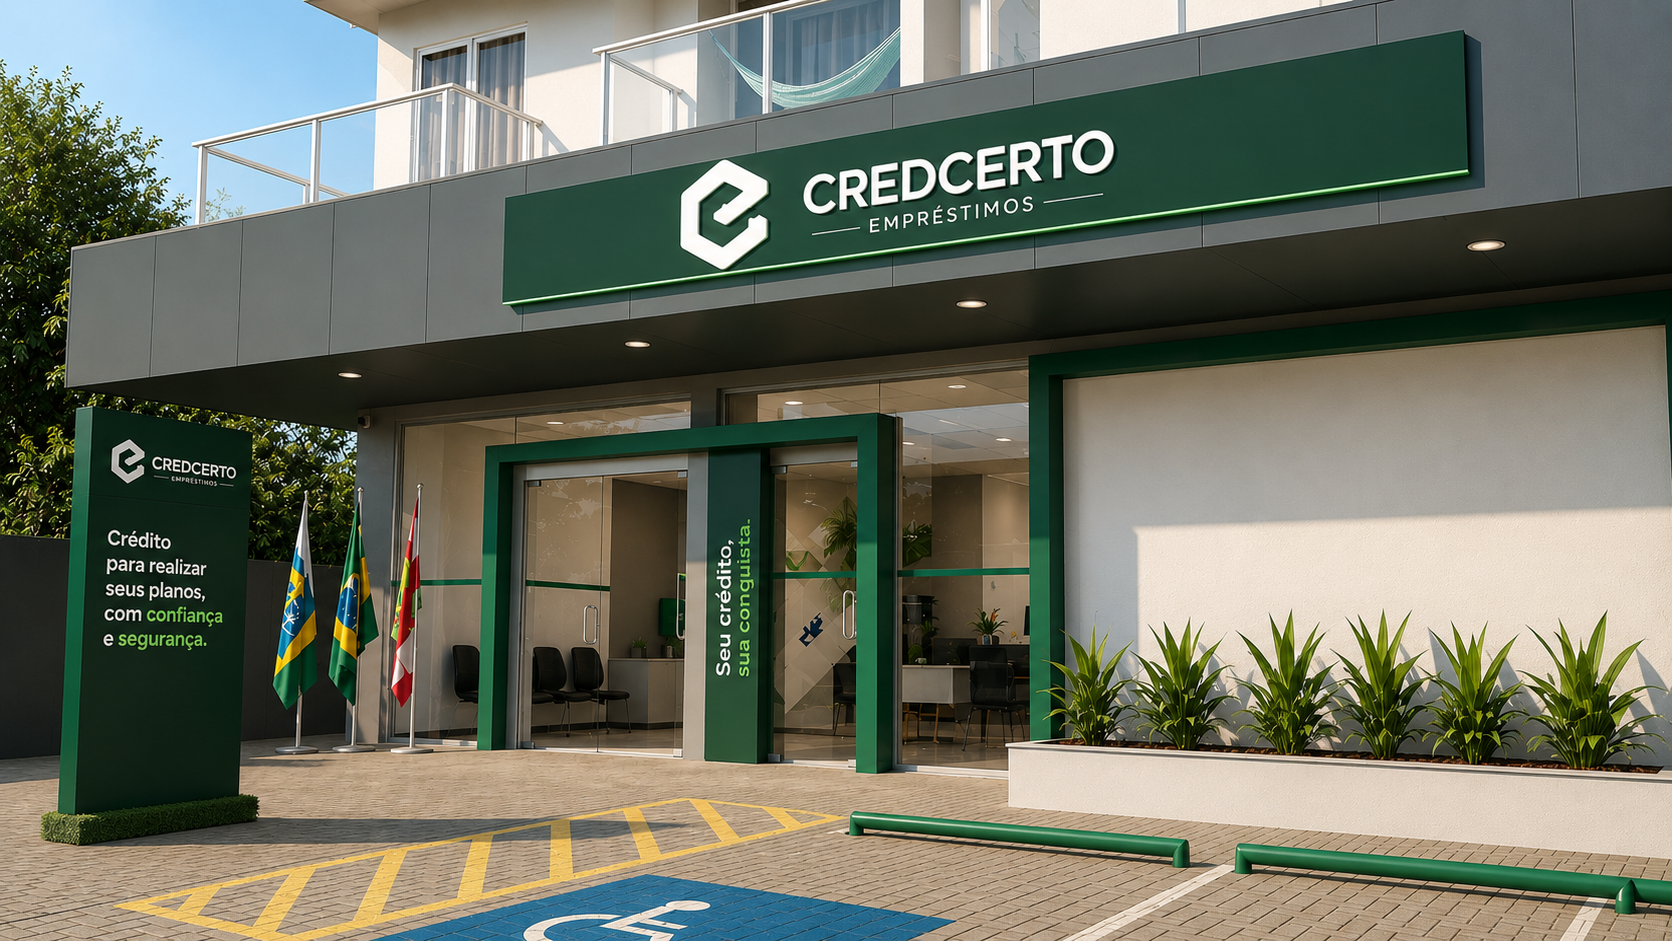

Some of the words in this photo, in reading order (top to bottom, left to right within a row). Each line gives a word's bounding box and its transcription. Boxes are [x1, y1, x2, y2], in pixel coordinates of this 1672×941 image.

[803, 129, 1115, 215] CREDCERTO
[869, 195, 1035, 234] EMPRÉSTIMOS
[151, 456, 237, 480] CREDCERTO
[107, 529, 172, 550] Crédito
[106, 558, 145, 575] para
[149, 558, 207, 577] realizar
[714, 539, 735, 627] crédito,
[737, 518, 755, 633] conquista.
[105, 583, 145, 598] seus
[148, 582, 206, 602] planos,
[104, 608, 142, 622] com
[146, 606, 223, 627] confiança
[103, 634, 114, 647] e
[118, 633, 207, 651] segurança.
[715, 633, 732, 677] Seu
[738, 639, 750, 677] sua
